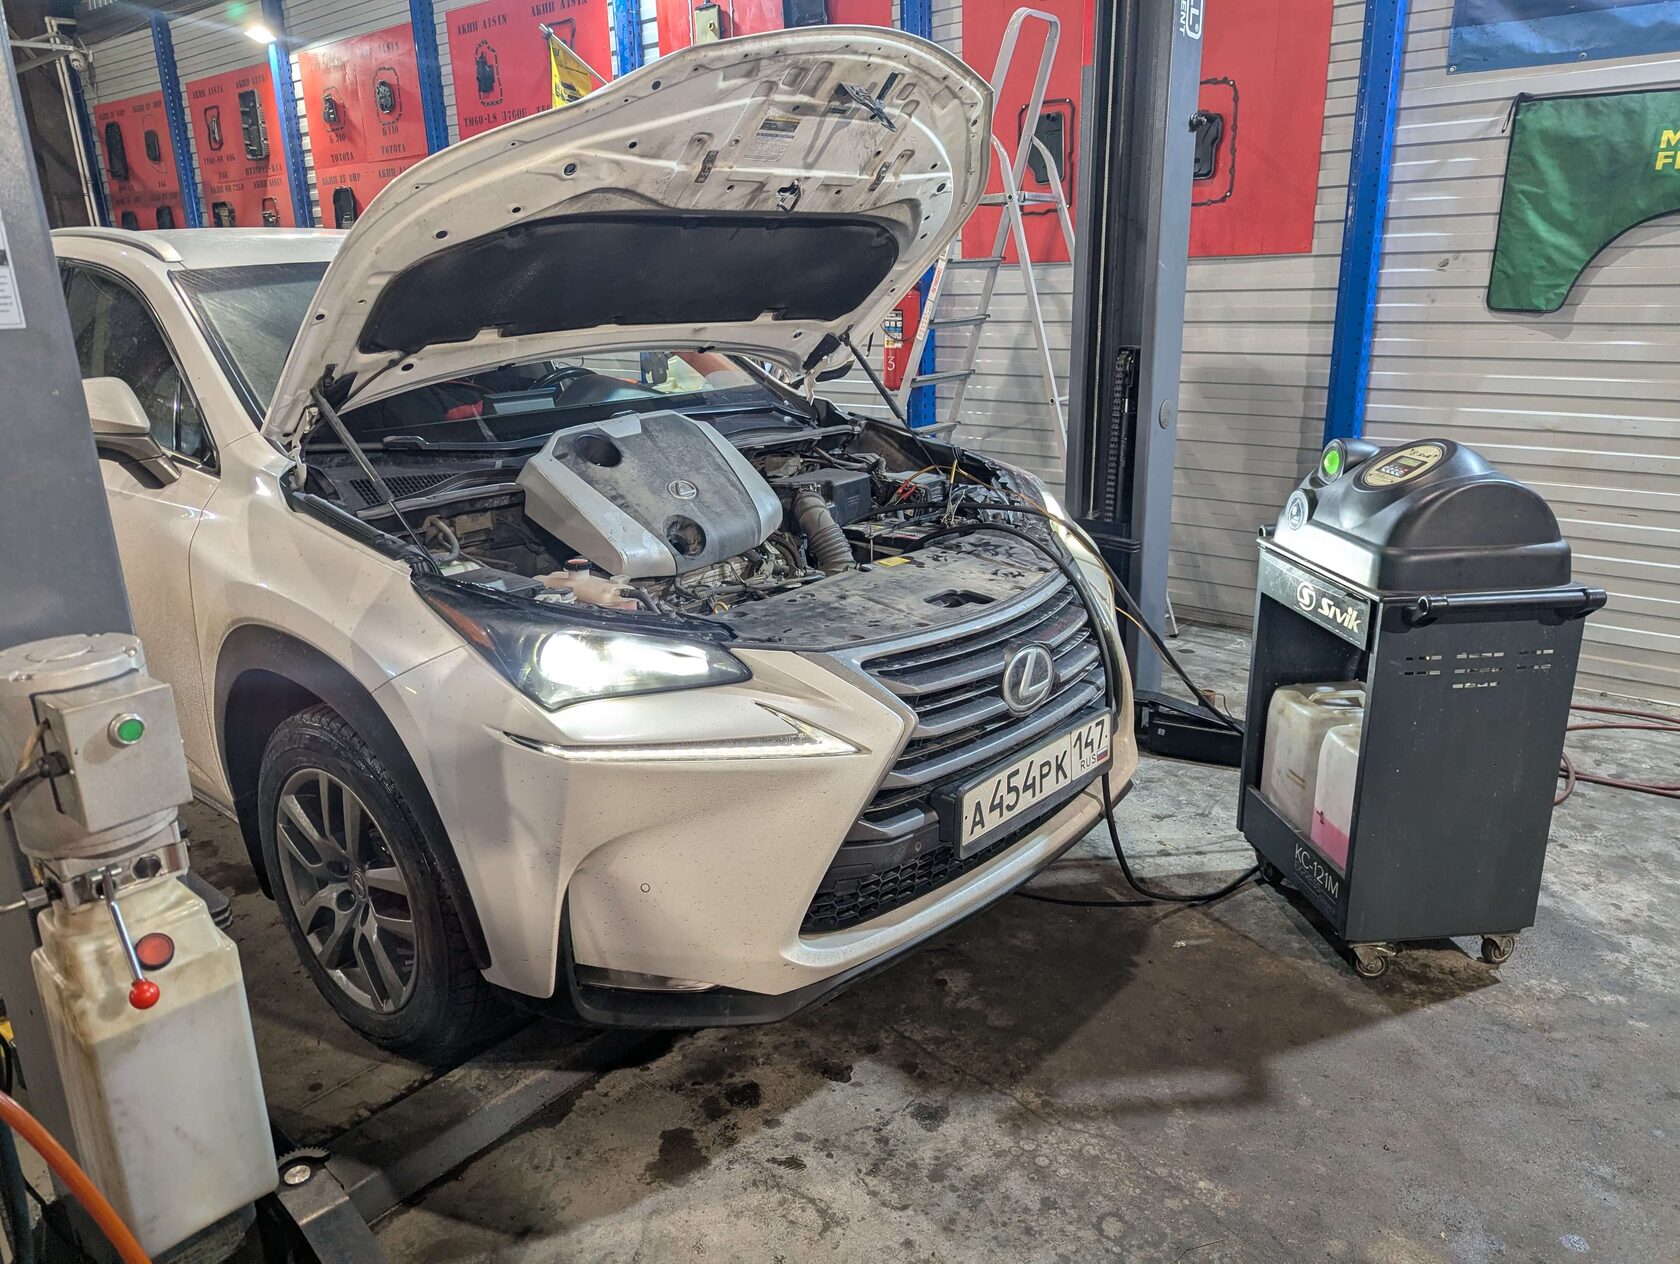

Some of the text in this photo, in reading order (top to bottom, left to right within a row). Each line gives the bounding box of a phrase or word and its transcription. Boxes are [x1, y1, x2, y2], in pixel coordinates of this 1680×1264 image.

[482, 14, 507, 29] AISIN
[330, 151, 355, 163] TOYOTA
[381, 143, 407, 155] TOYOTA
[887, 355, 896, 371] 3
[1317, 597, 1362, 633] Sivik
[1080, 754, 1097, 771] RUS
[969, 719, 1106, 836] A454PK 147
